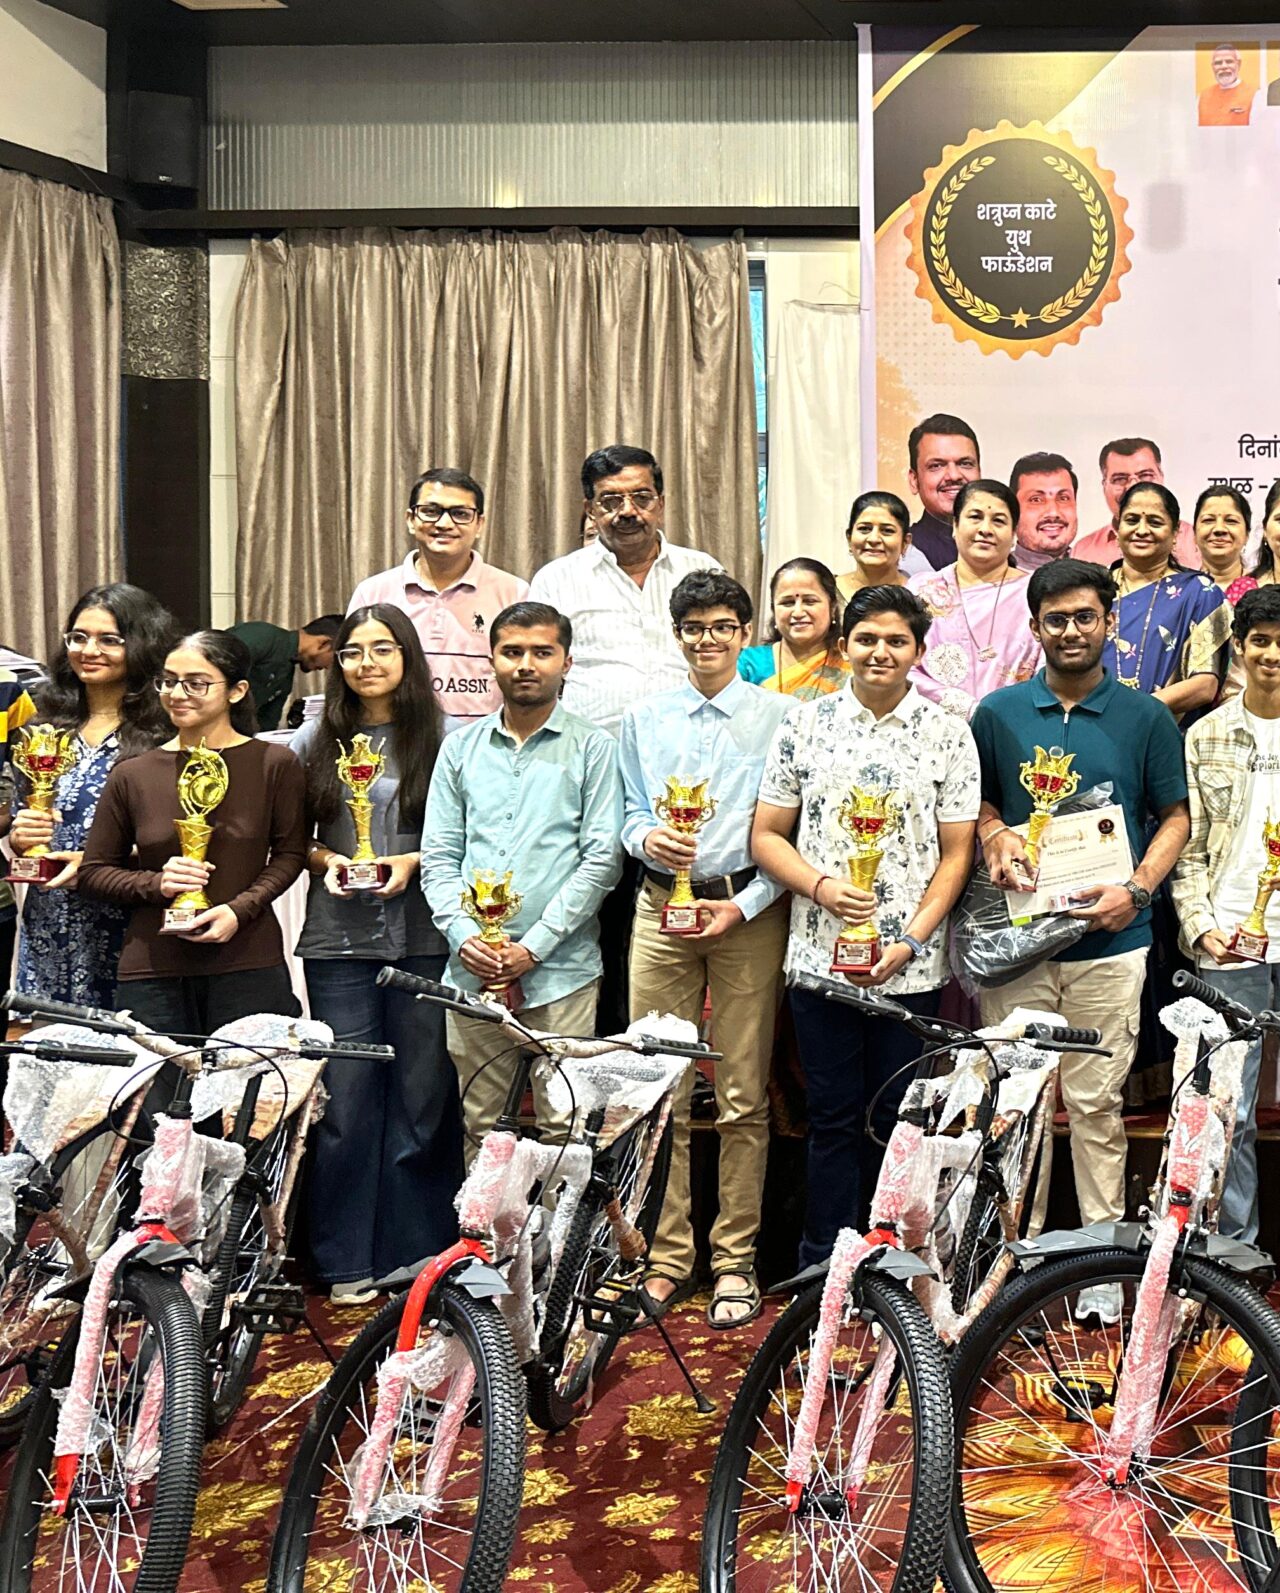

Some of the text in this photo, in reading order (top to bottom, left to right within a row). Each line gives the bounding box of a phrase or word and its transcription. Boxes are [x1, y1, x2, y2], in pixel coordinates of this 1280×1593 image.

[977, 198, 1057, 227] शत्रुघ्न काटे
[1005, 229, 1032, 253] युथ
[981, 251, 1053, 273] फाऊंडेशन
